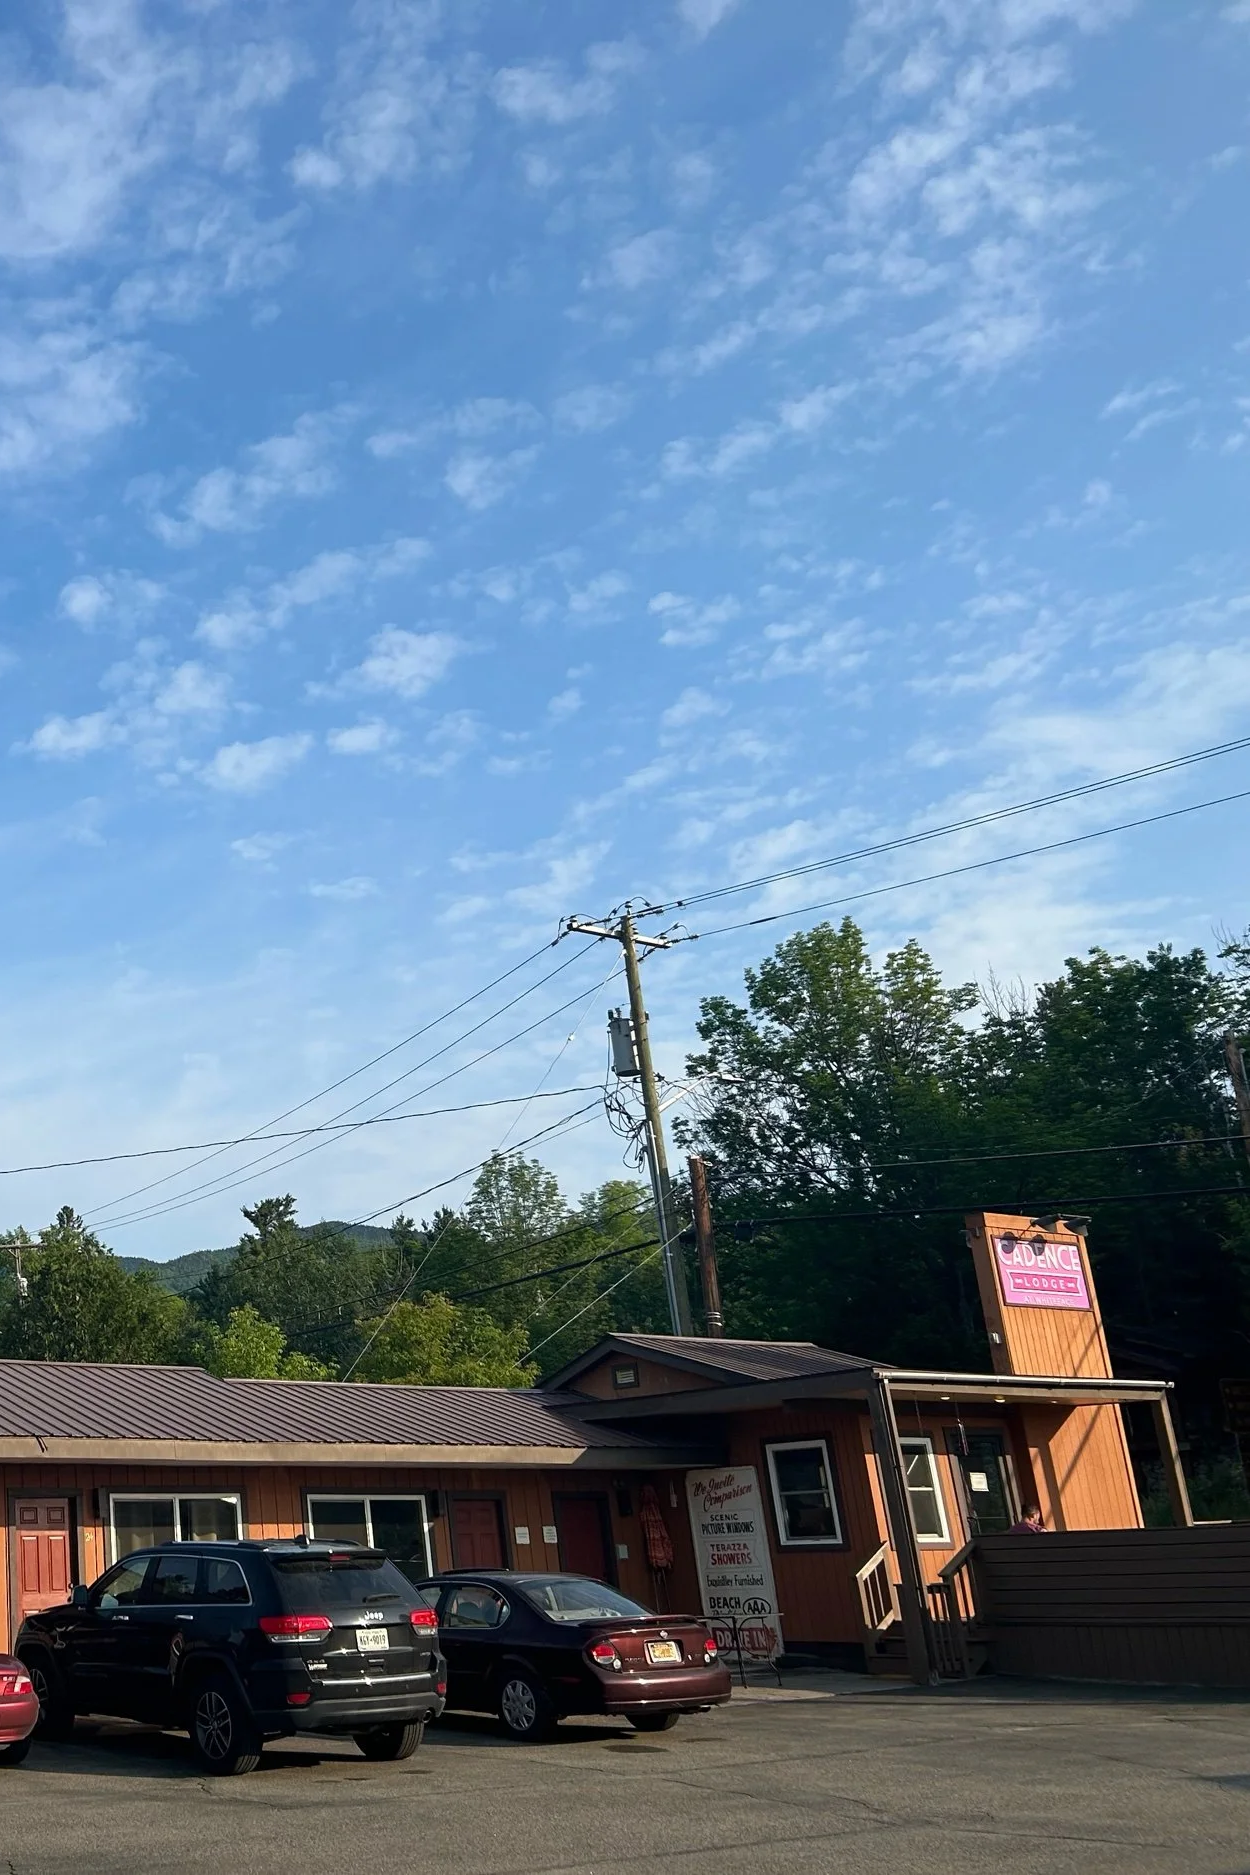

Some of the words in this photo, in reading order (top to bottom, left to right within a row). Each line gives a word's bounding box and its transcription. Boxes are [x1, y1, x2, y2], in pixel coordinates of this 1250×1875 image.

[997, 1239, 1081, 1271] CADENCE
[1023, 1276, 1066, 1290] LODGE
[703, 1484, 752, 1512] Comparison
[710, 1513, 739, 1522] SCENIC
[702, 1523, 726, 1535] PICTURE
[727, 1521, 754, 1534] WINDOWS
[710, 1543, 749, 1551] TERAZZA
[711, 1552, 752, 1566] SHOWERS
[734, 1574, 764, 1586] Furnished
[709, 1597, 741, 1609] BEACH
[747, 1600, 767, 1614] AAA
[364, 1611, 384, 1621] Jeep
